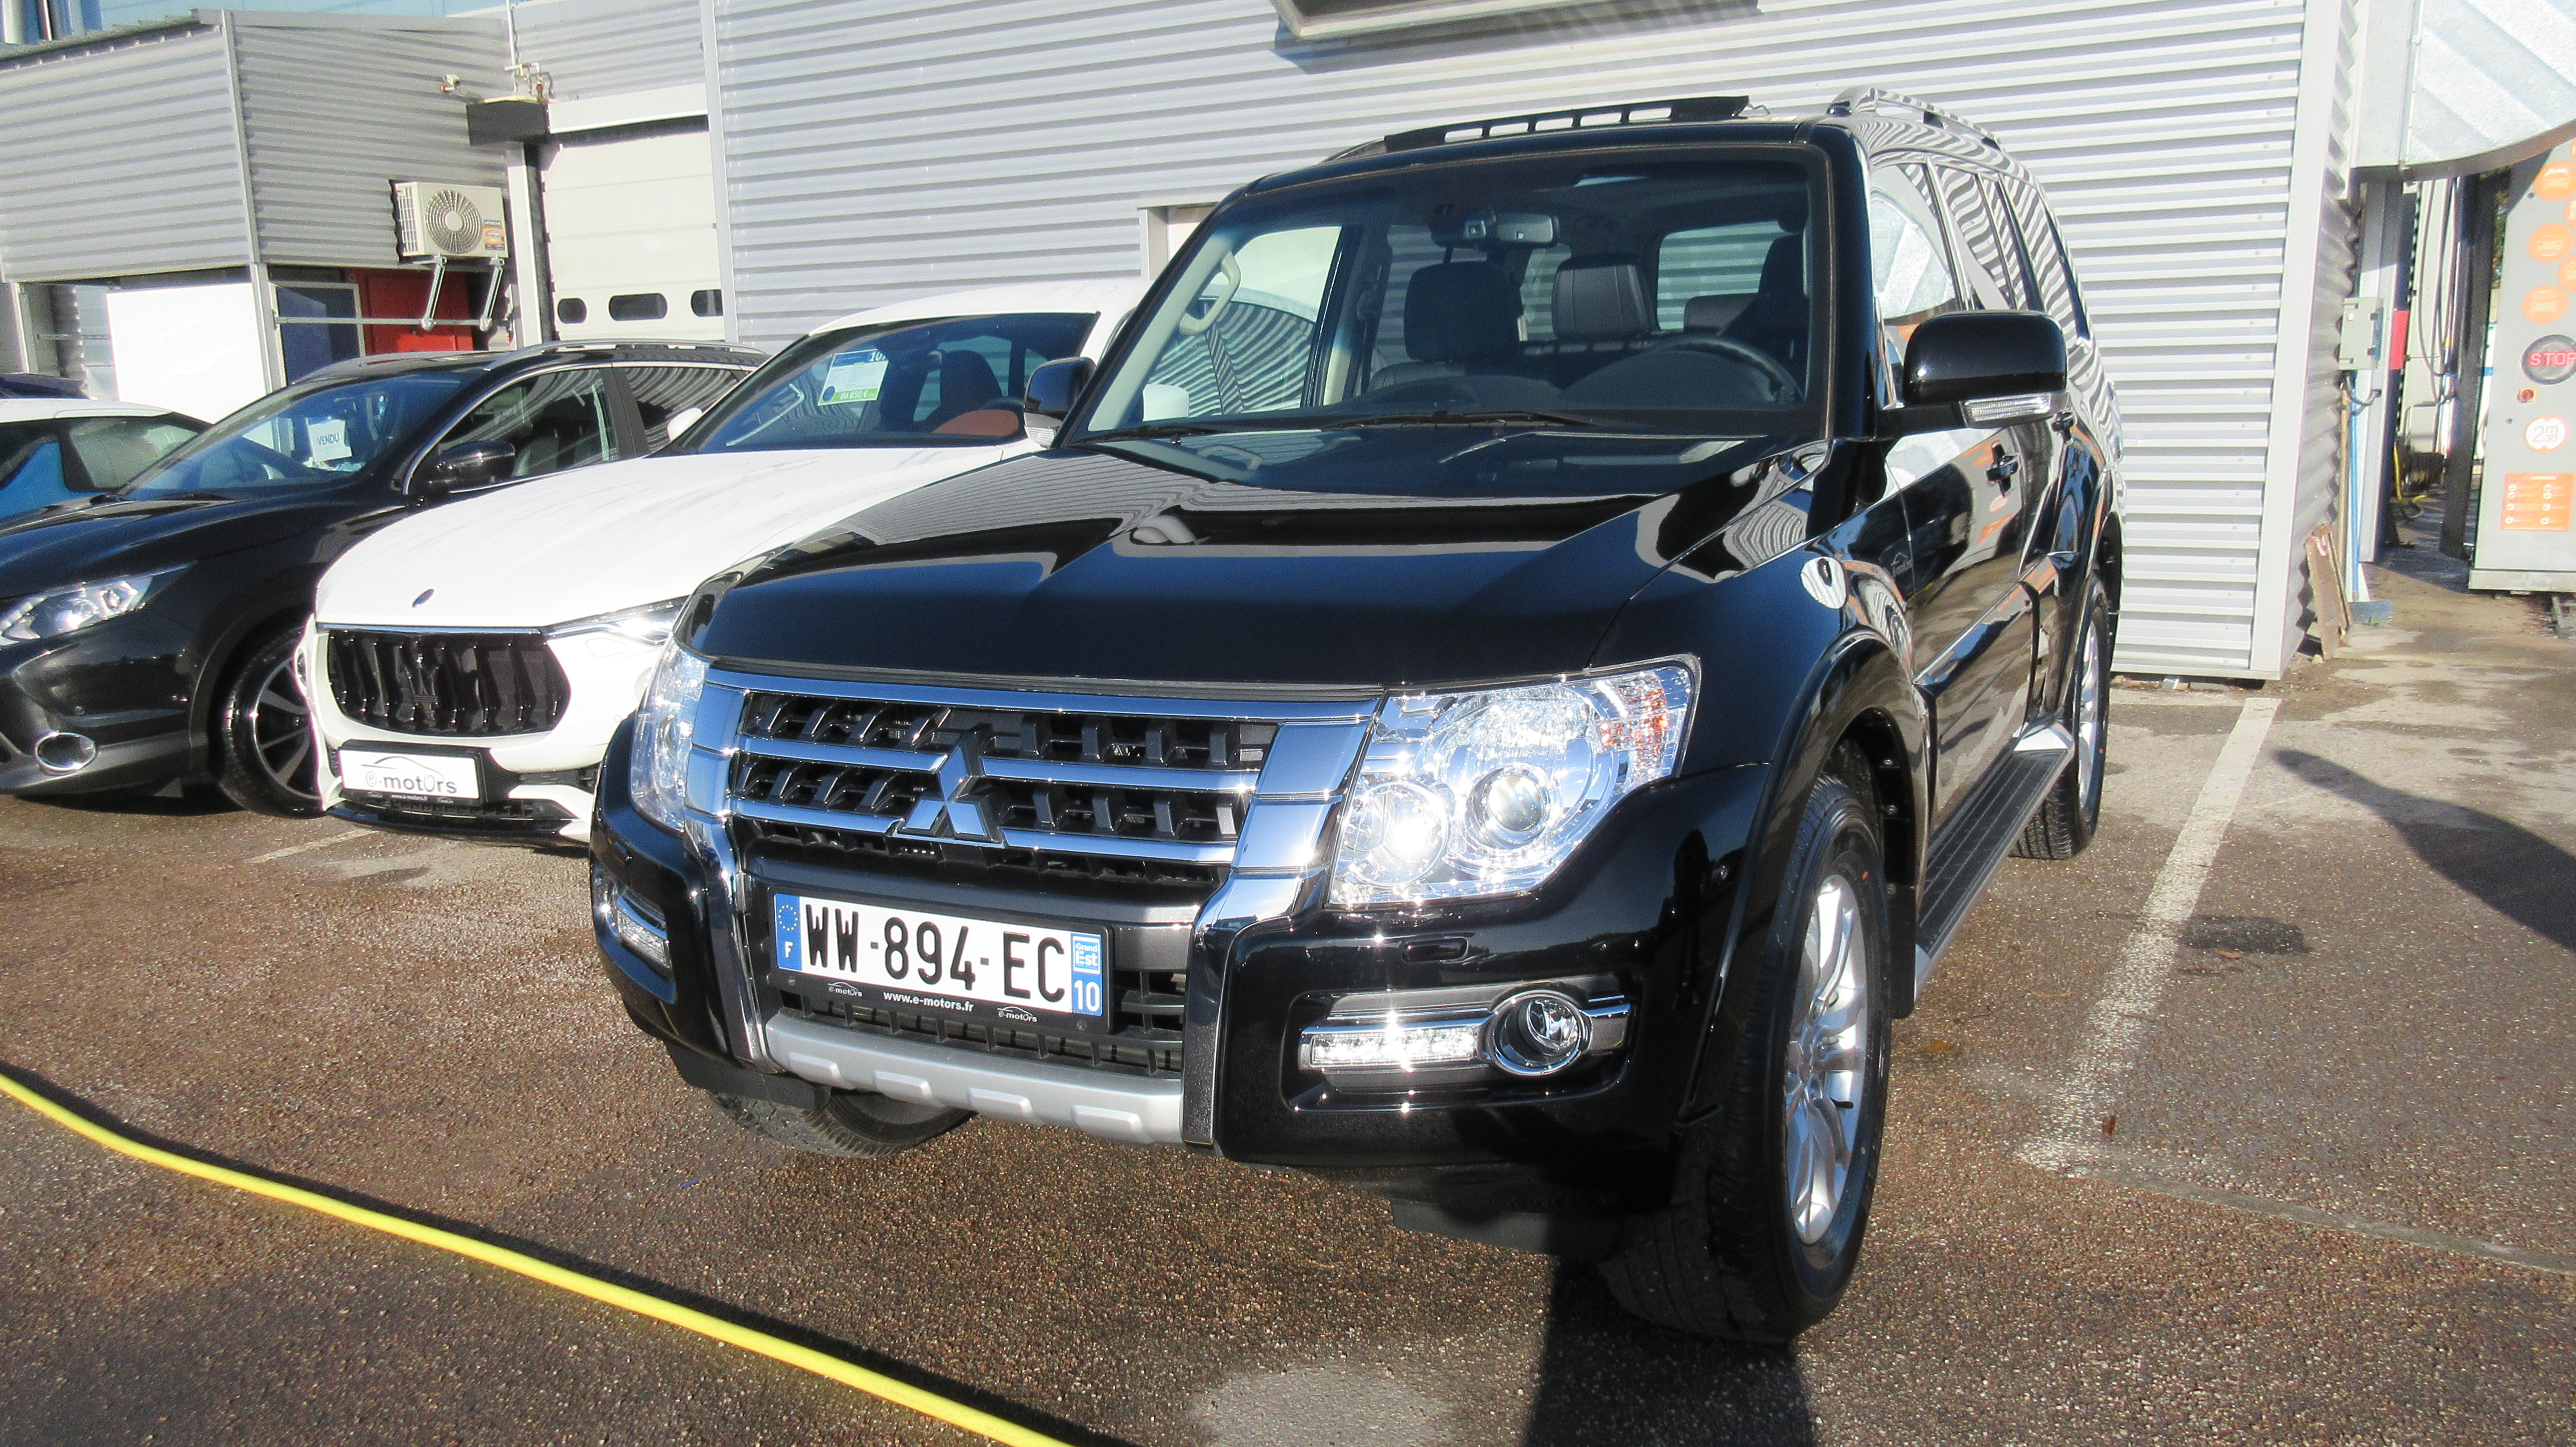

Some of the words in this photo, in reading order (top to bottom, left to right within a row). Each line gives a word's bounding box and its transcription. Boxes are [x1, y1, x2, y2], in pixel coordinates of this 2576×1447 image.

[2529, 352, 2576, 366] STOP
[317, 433, 339, 446] VENDU
[784, 941, 794, 958] F
[805, 904, 1065, 1002] WW-894-EC
[1075, 943, 1098, 952] Grand
[1076, 950, 1098, 966] Est
[884, 992, 974, 1012] www.e-motors.fr
[1074, 979, 1100, 1012] 10
